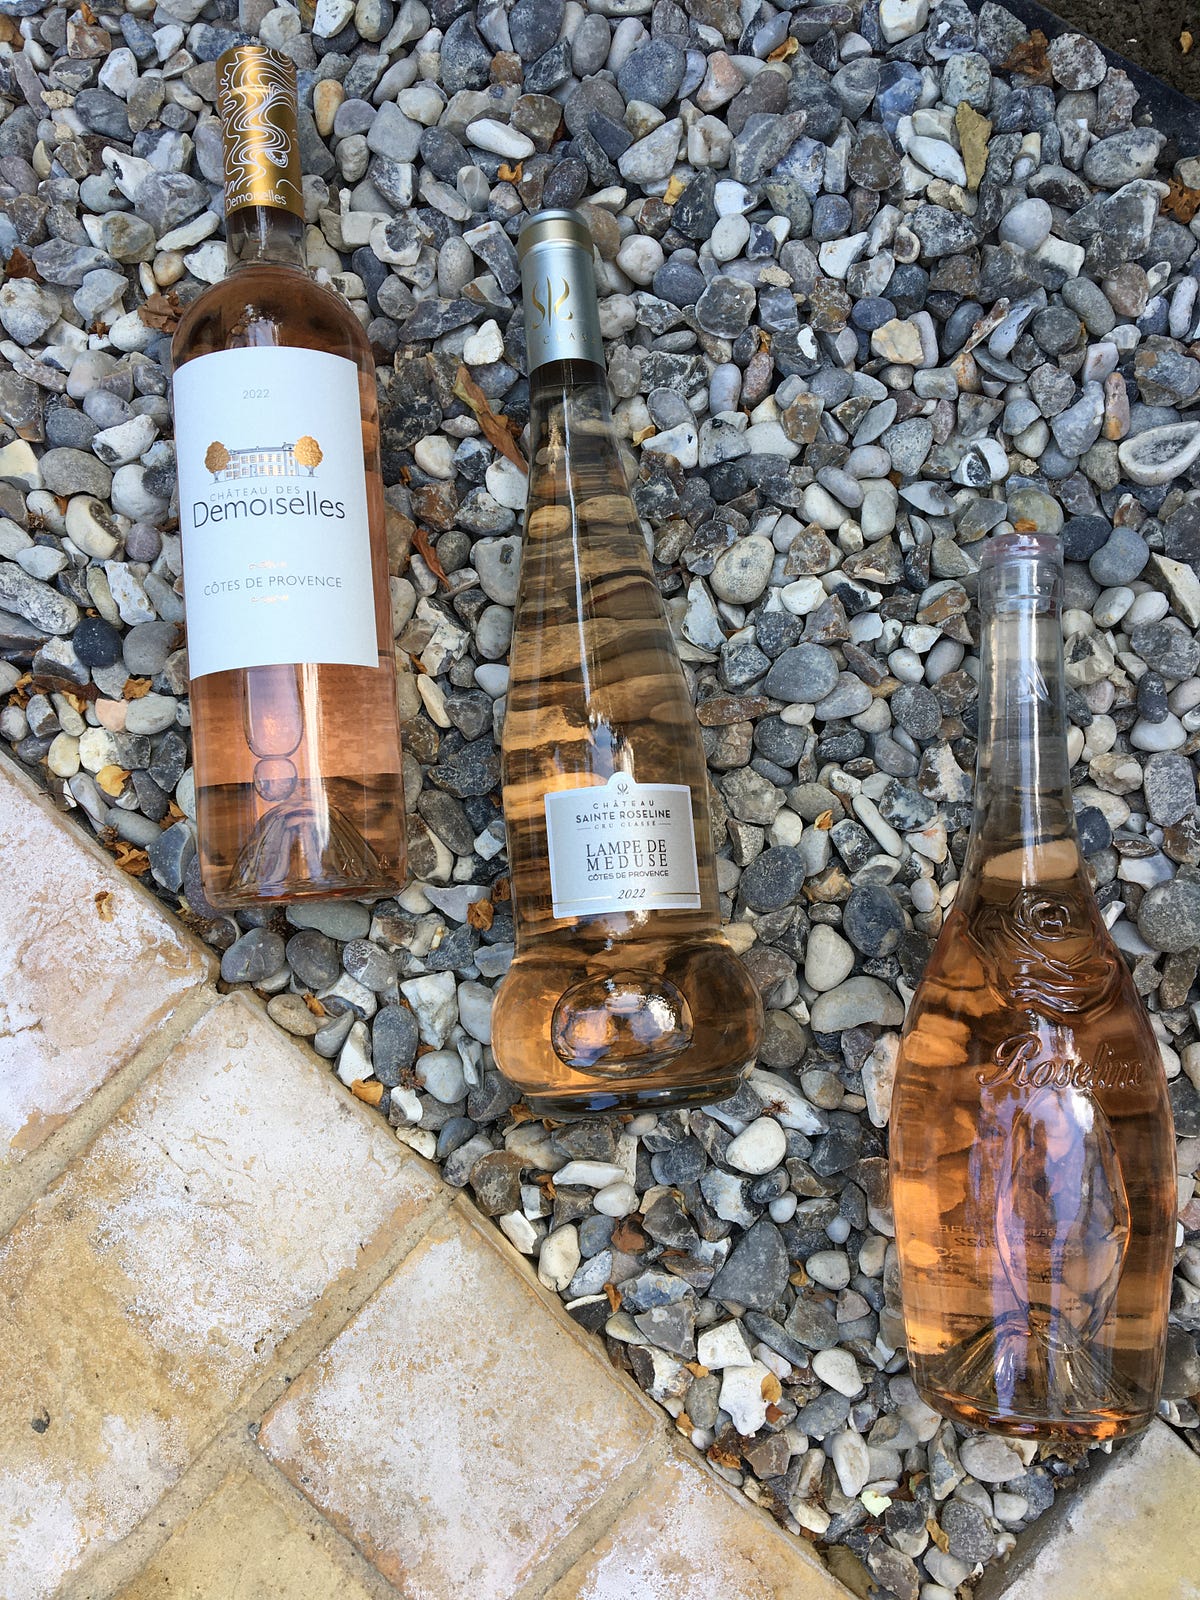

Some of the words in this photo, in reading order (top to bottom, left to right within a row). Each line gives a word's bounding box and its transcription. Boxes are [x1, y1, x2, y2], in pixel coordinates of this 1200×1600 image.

[225, 189, 287, 211] Demoielles
[242, 388, 270, 399] 2022
[209, 485, 268, 501] CHÂTEAU
[276, 485, 301, 495] DES
[193, 491, 346, 528] Demoiselles
[203, 580, 240, 597] CÔTES
[246, 577, 263, 589] DE
[269, 575, 343, 588] PROVENCE
[593, 800, 654, 809] CHÂTEAU
[576, 811, 616, 824] SAINTE
[620, 809, 671, 819] ROSELINE
[586, 840, 642, 858] LAMPE
[647, 839, 667, 853] DE
[587, 853, 668, 872] MEDUSE
[588, 873, 614, 881] CÔTES
[628, 870, 670, 878] PROVENCE
[617, 888, 646, 900] 2022
[975, 1031, 1143, 1089] Roseline
